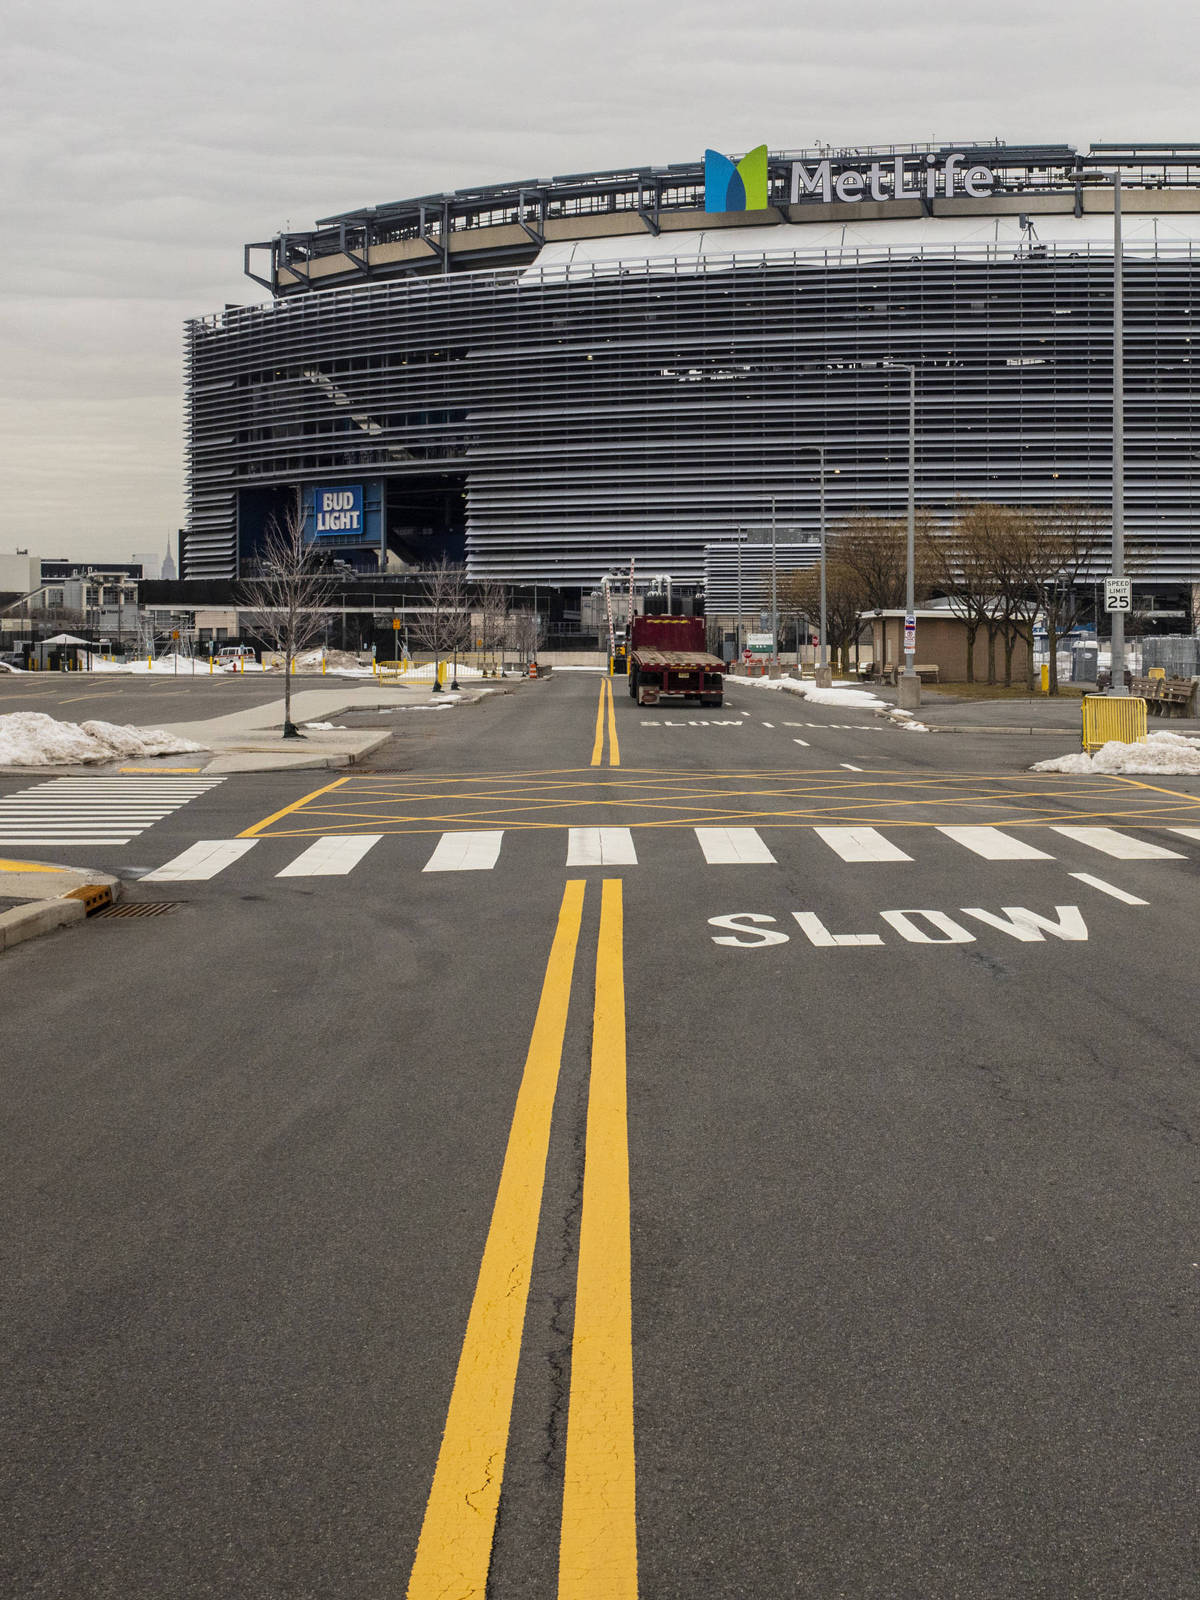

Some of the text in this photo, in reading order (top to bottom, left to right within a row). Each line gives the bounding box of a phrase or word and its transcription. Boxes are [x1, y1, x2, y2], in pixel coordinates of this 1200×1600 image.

[790, 153, 994, 204] MetLife
[322, 491, 354, 511] BUD
[317, 510, 360, 531] LIGHT
[1107, 595, 1129, 608] 25
[707, 905, 1089, 948] SLOW
